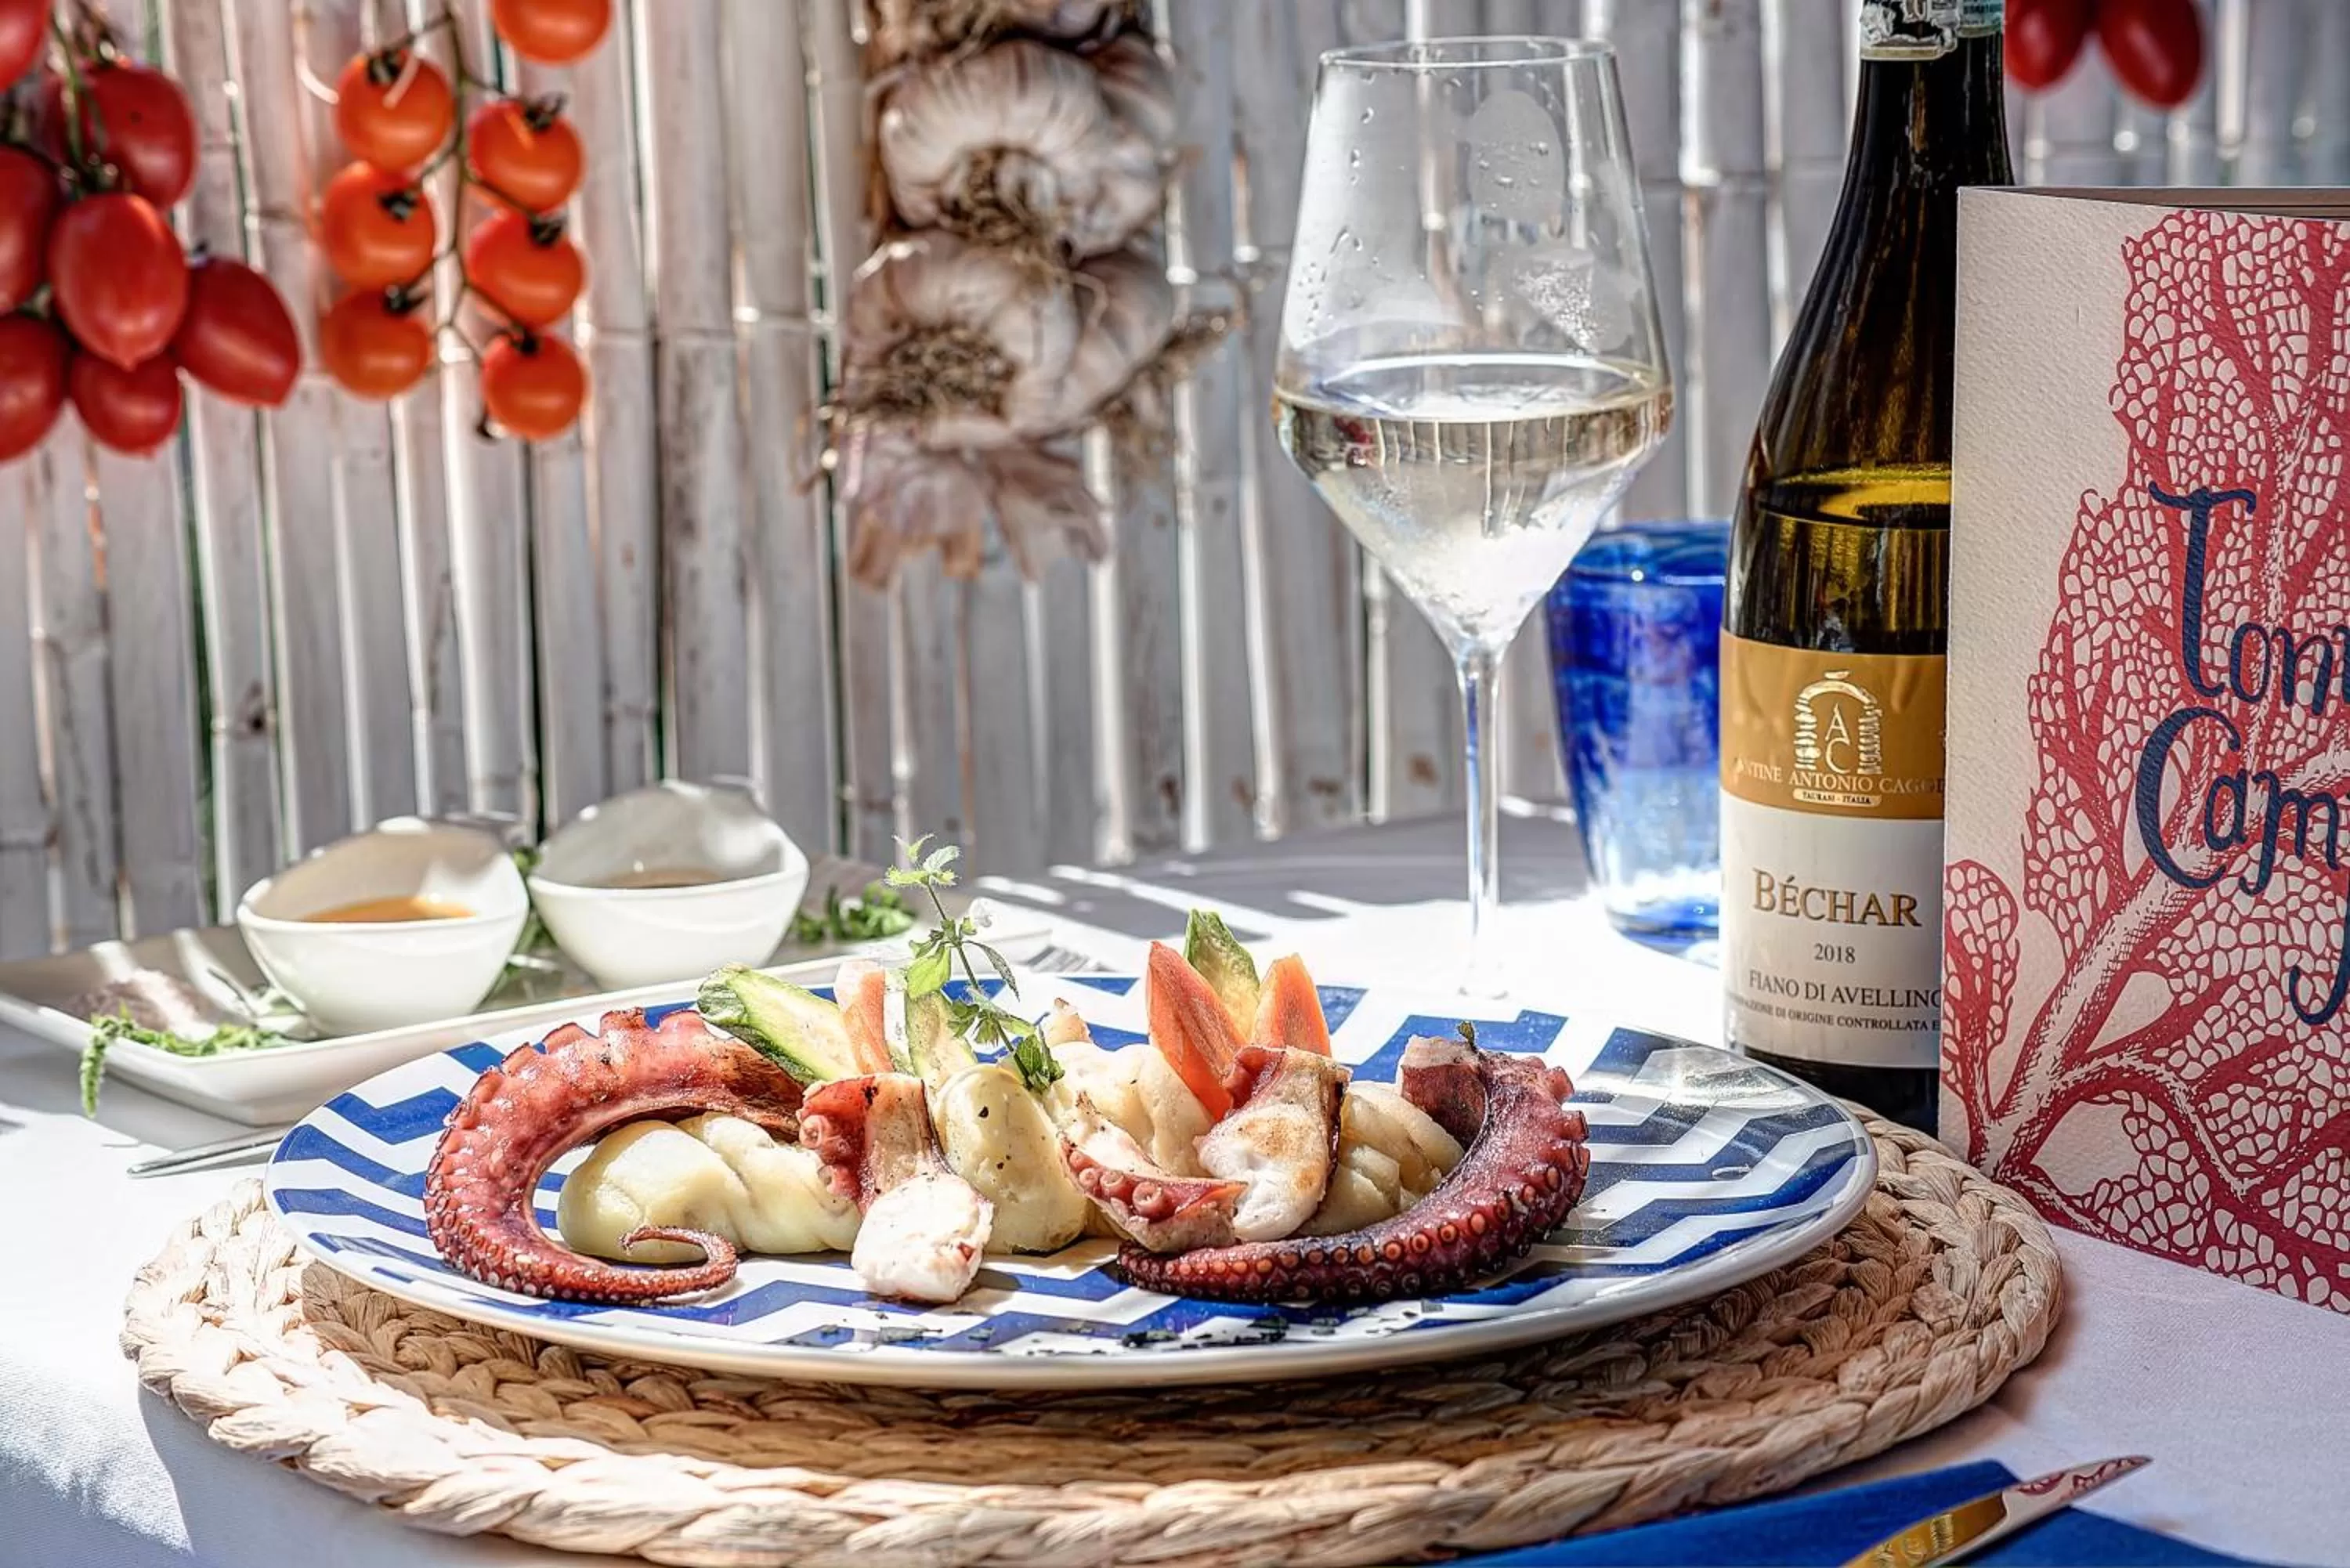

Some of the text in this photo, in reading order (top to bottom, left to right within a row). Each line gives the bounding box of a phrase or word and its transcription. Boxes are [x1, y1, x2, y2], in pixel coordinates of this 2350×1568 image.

[1788, 770, 1874, 793] ANTONIO
[1752, 867, 1922, 927] BÉCHAR
[1813, 943, 1856, 964] 2018
[1748, 969, 1799, 999] FIANO
[1804, 981, 1826, 1002] DI
[1788, 1008, 1835, 1027] ORIGINE
[1836, 1015, 1929, 1031] CONTROLLATA
